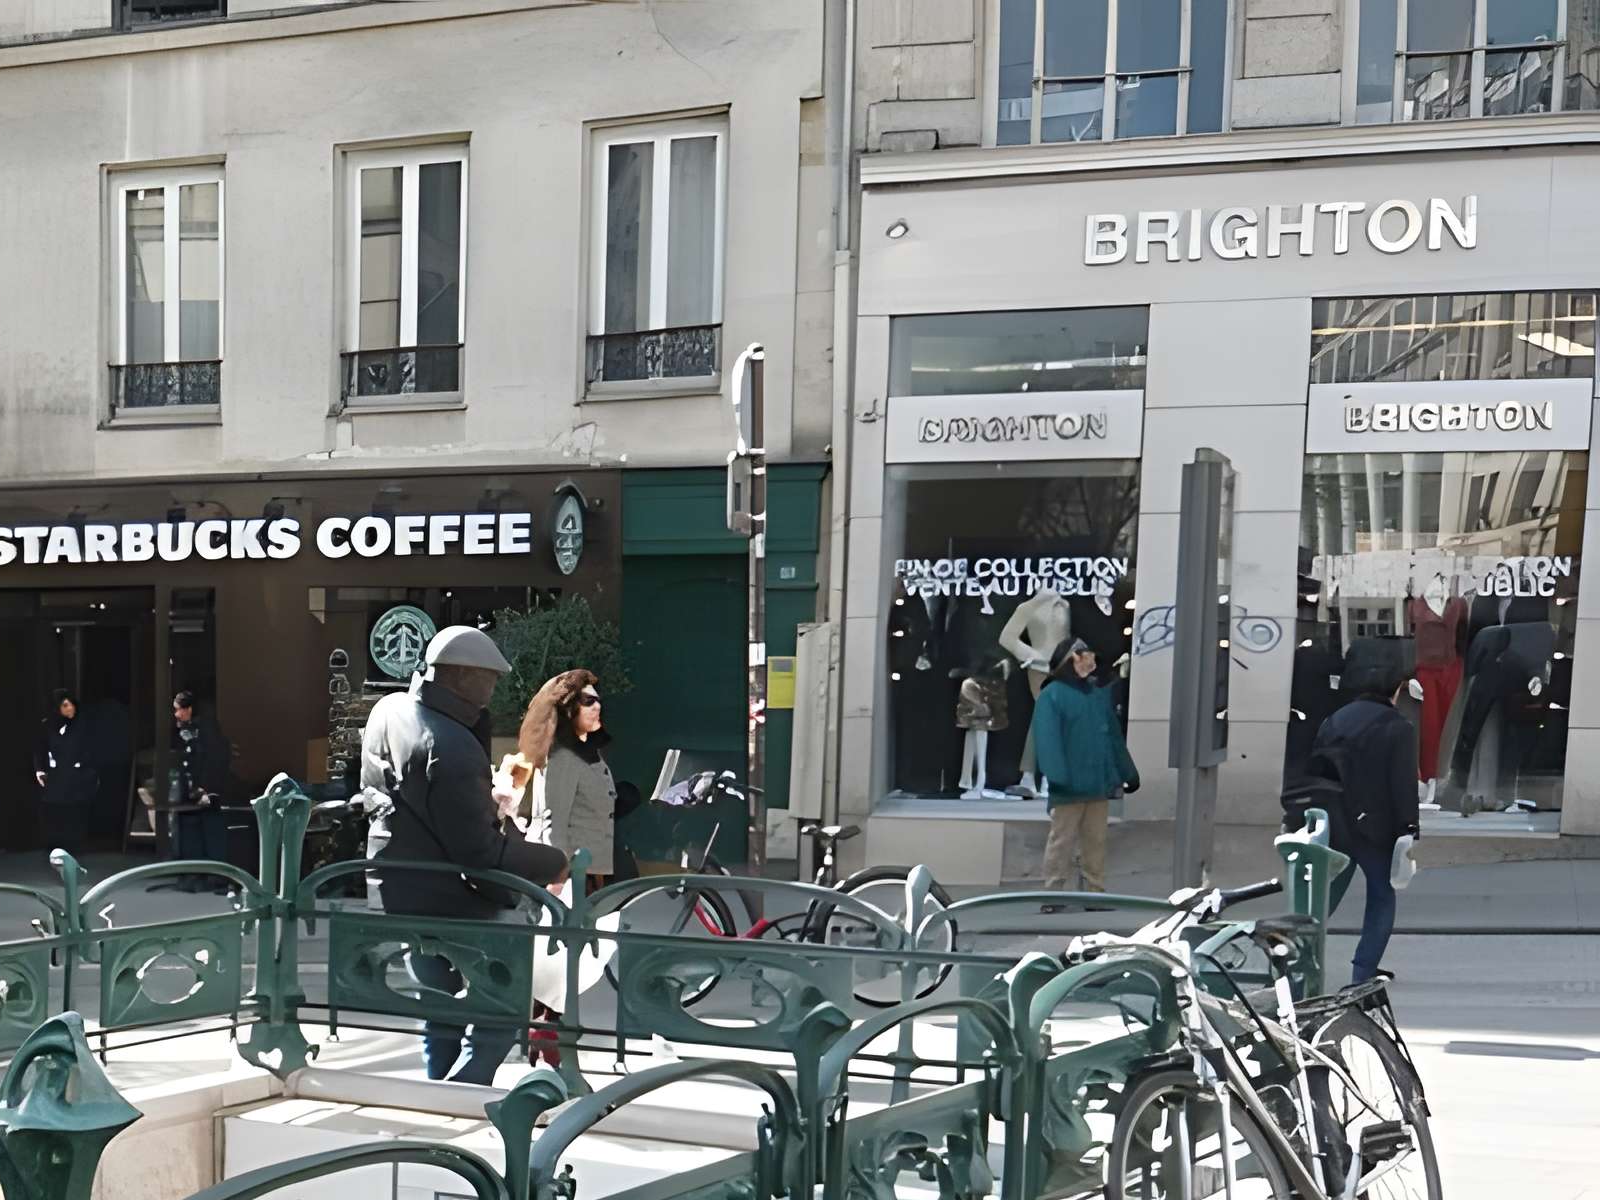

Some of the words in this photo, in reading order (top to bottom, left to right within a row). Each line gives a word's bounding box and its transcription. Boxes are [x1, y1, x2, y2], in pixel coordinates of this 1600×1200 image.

[1084, 195, 1478, 266] BRIGHTON
[315, 512, 532, 559] COFFEE
[973, 557, 1129, 578] COLLECTION
